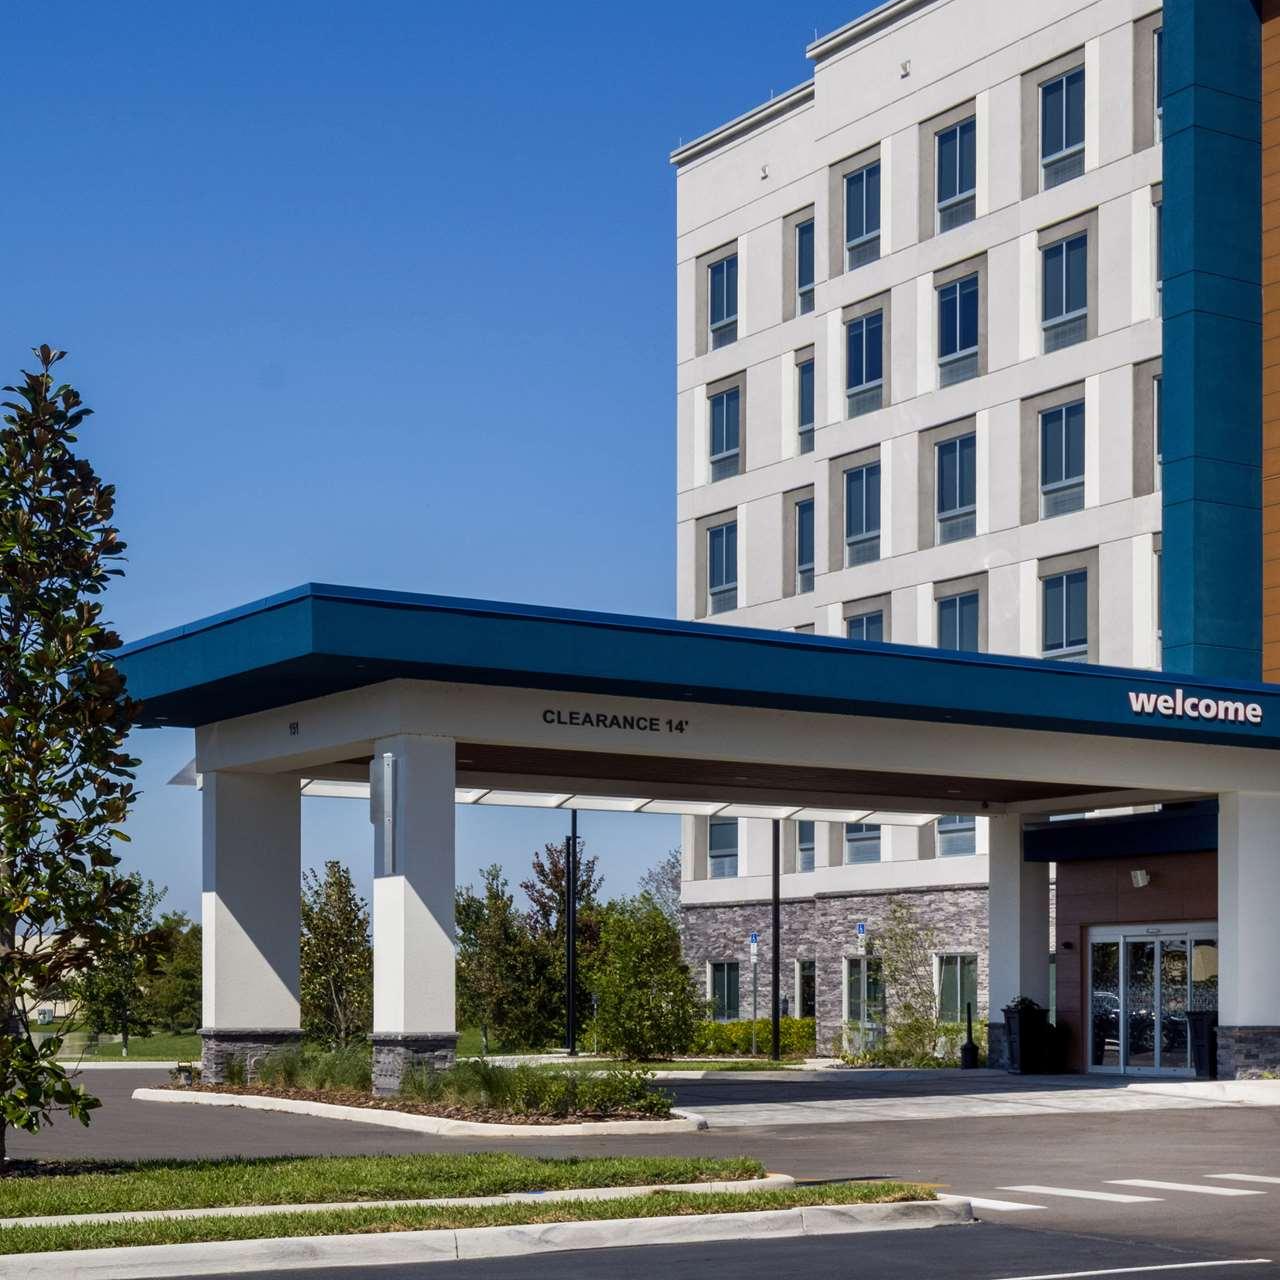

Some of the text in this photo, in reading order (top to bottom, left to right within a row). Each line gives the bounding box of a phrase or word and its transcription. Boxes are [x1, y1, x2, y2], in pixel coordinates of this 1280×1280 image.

[1128, 688, 1263, 724] welcome
[542, 709, 689, 734] CLEARANCE 14'
